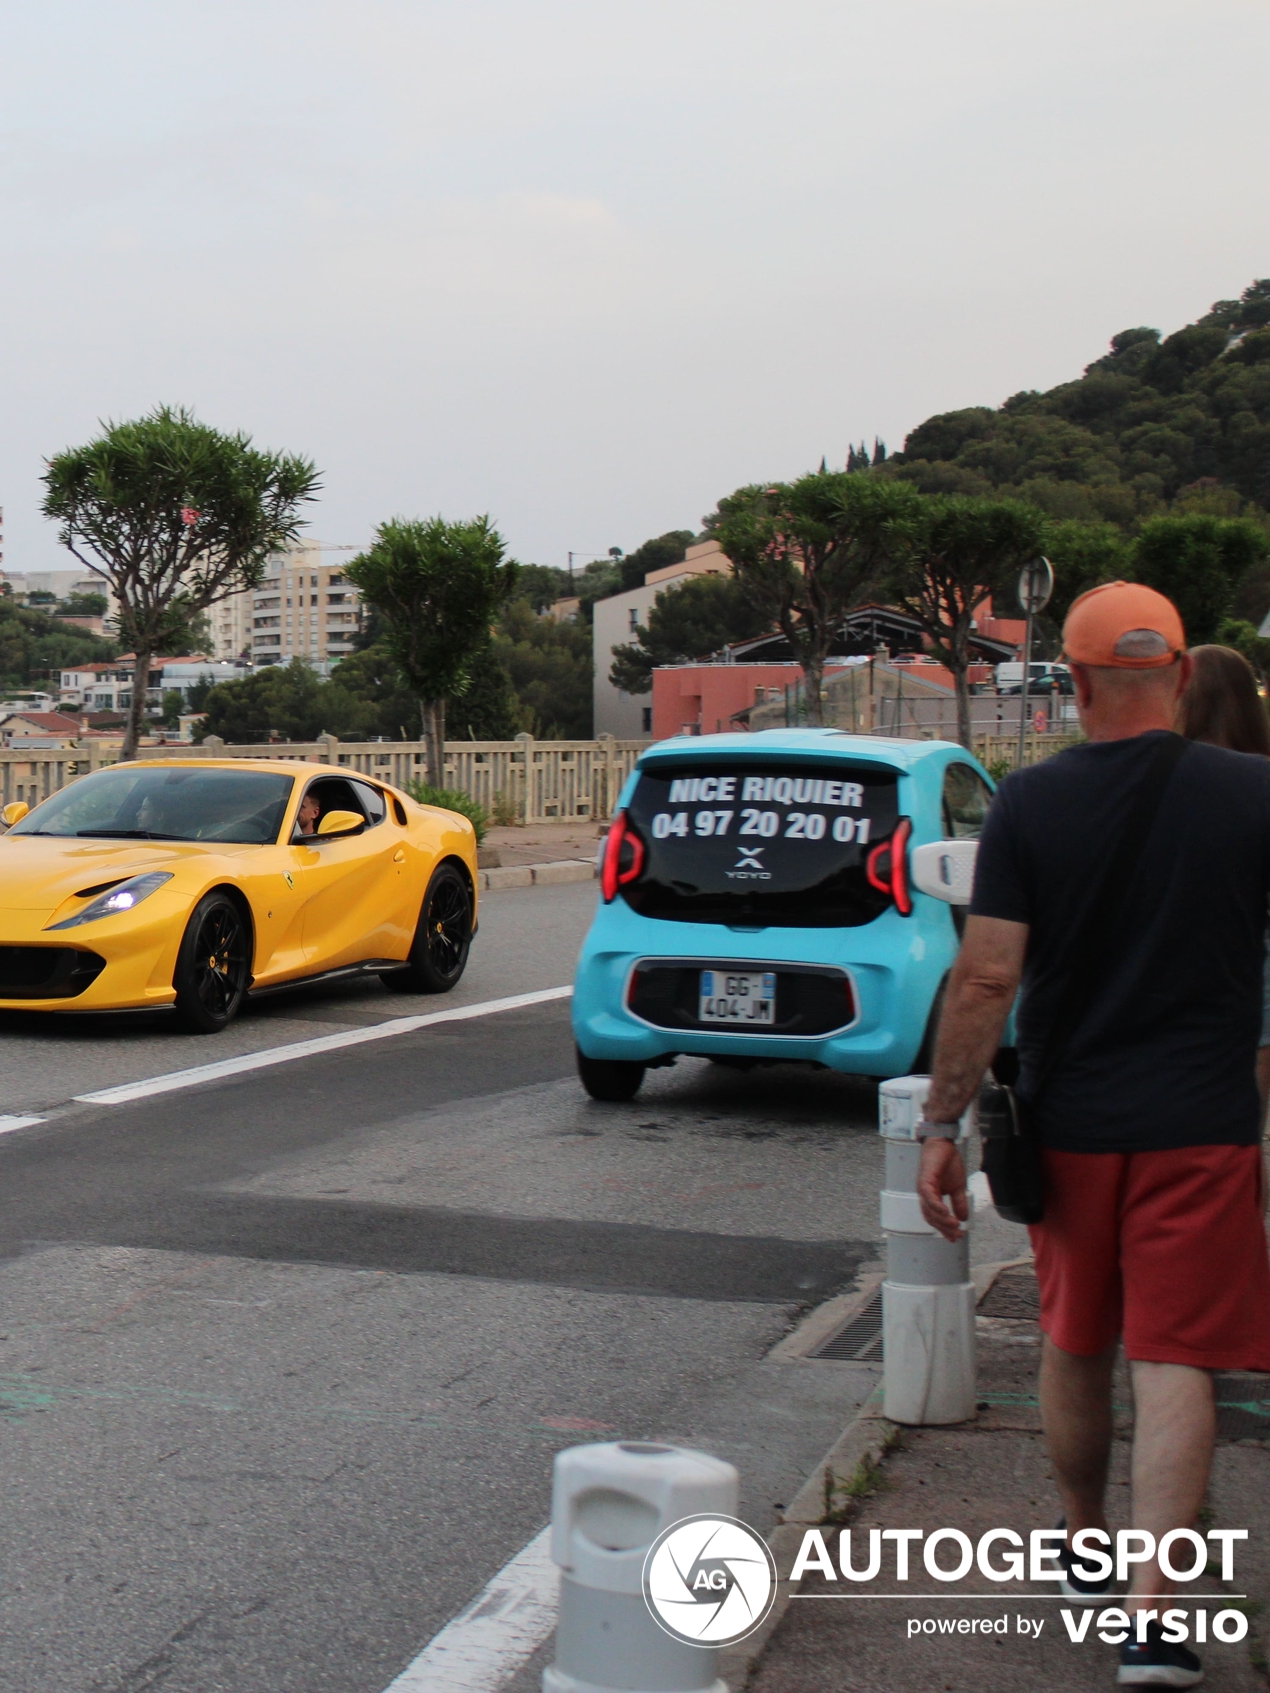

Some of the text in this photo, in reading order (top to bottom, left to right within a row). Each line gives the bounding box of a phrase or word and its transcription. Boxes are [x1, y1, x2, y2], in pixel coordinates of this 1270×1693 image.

[668, 777, 864, 807] NICE RIQUIER
[651, 808, 871, 844] 04 97 20 20 01
[725, 871, 772, 880] YOYO
